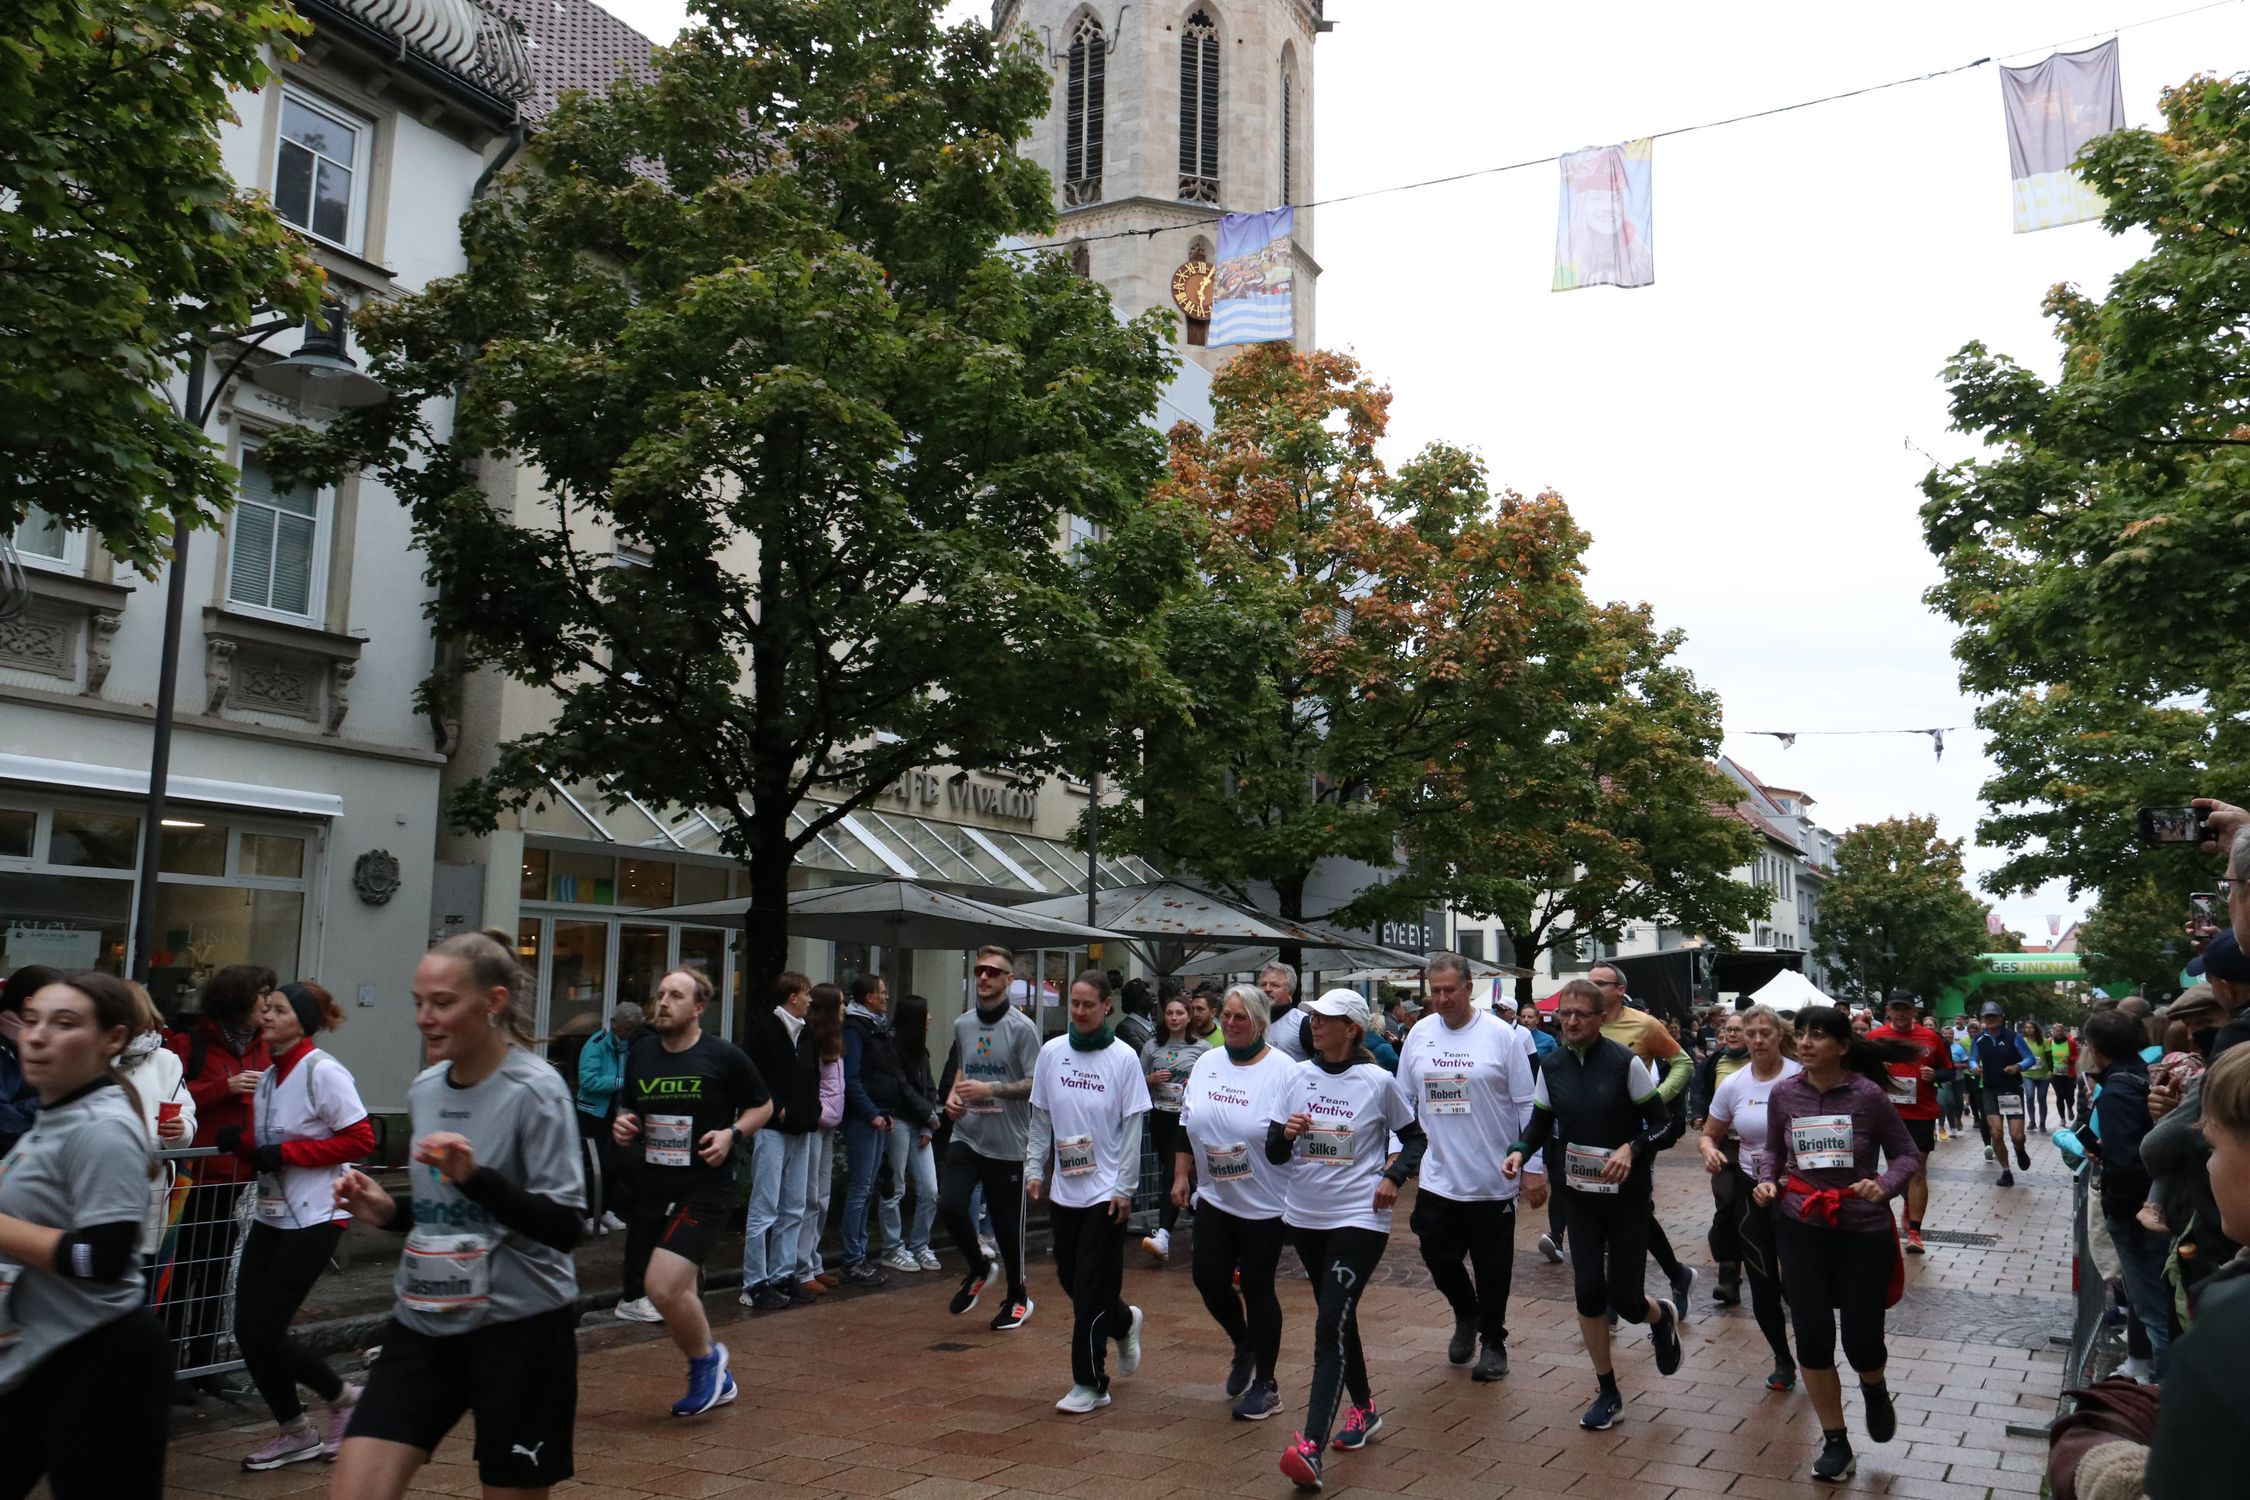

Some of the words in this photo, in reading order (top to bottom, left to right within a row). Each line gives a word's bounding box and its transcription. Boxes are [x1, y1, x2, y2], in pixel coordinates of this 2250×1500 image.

[880, 770, 940, 804] AFE
[946, 777, 1039, 819] VIVALDI
[1432, 1058, 1474, 1067] Vantive
[1072, 1069, 1100, 1080] Team
[638, 1076, 702, 1094] VOLZ
[1060, 1076, 1105, 1092] Vantive
[1220, 1085, 1246, 1095] Team
[1208, 1091, 1249, 1106] Vantive
[1430, 1088, 1461, 1099] Robert
[1319, 1095, 1349, 1106] Team
[1307, 1102, 1353, 1119] Vantive
[1309, 1142, 1337, 1156] Silke
[1799, 1139, 1845, 1152] Brigitte
